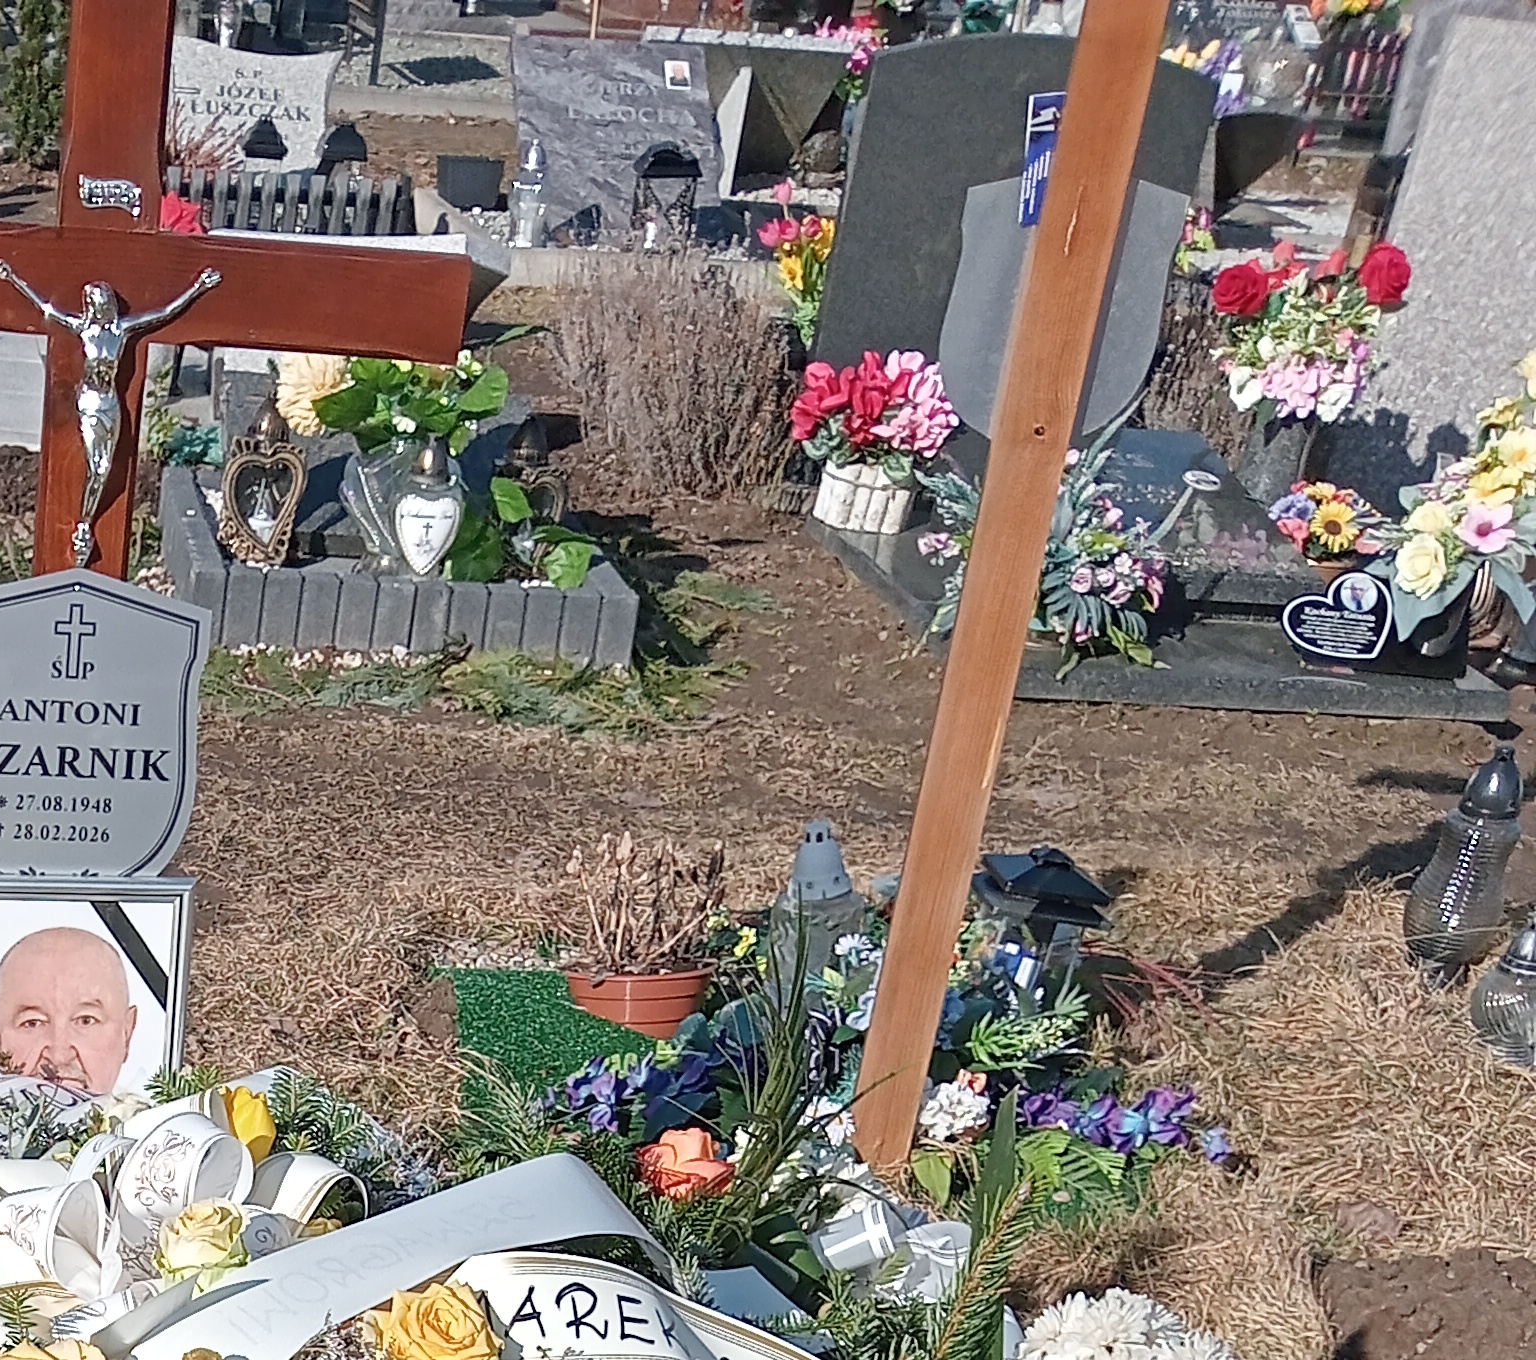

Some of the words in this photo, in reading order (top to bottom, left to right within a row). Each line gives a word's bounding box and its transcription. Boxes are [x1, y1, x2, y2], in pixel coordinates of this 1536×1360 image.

[215, 81, 286, 102] JÓZEF
[15, 794, 113, 815] 27.08.1948
[12, 823, 111, 843] 28.02.2026
